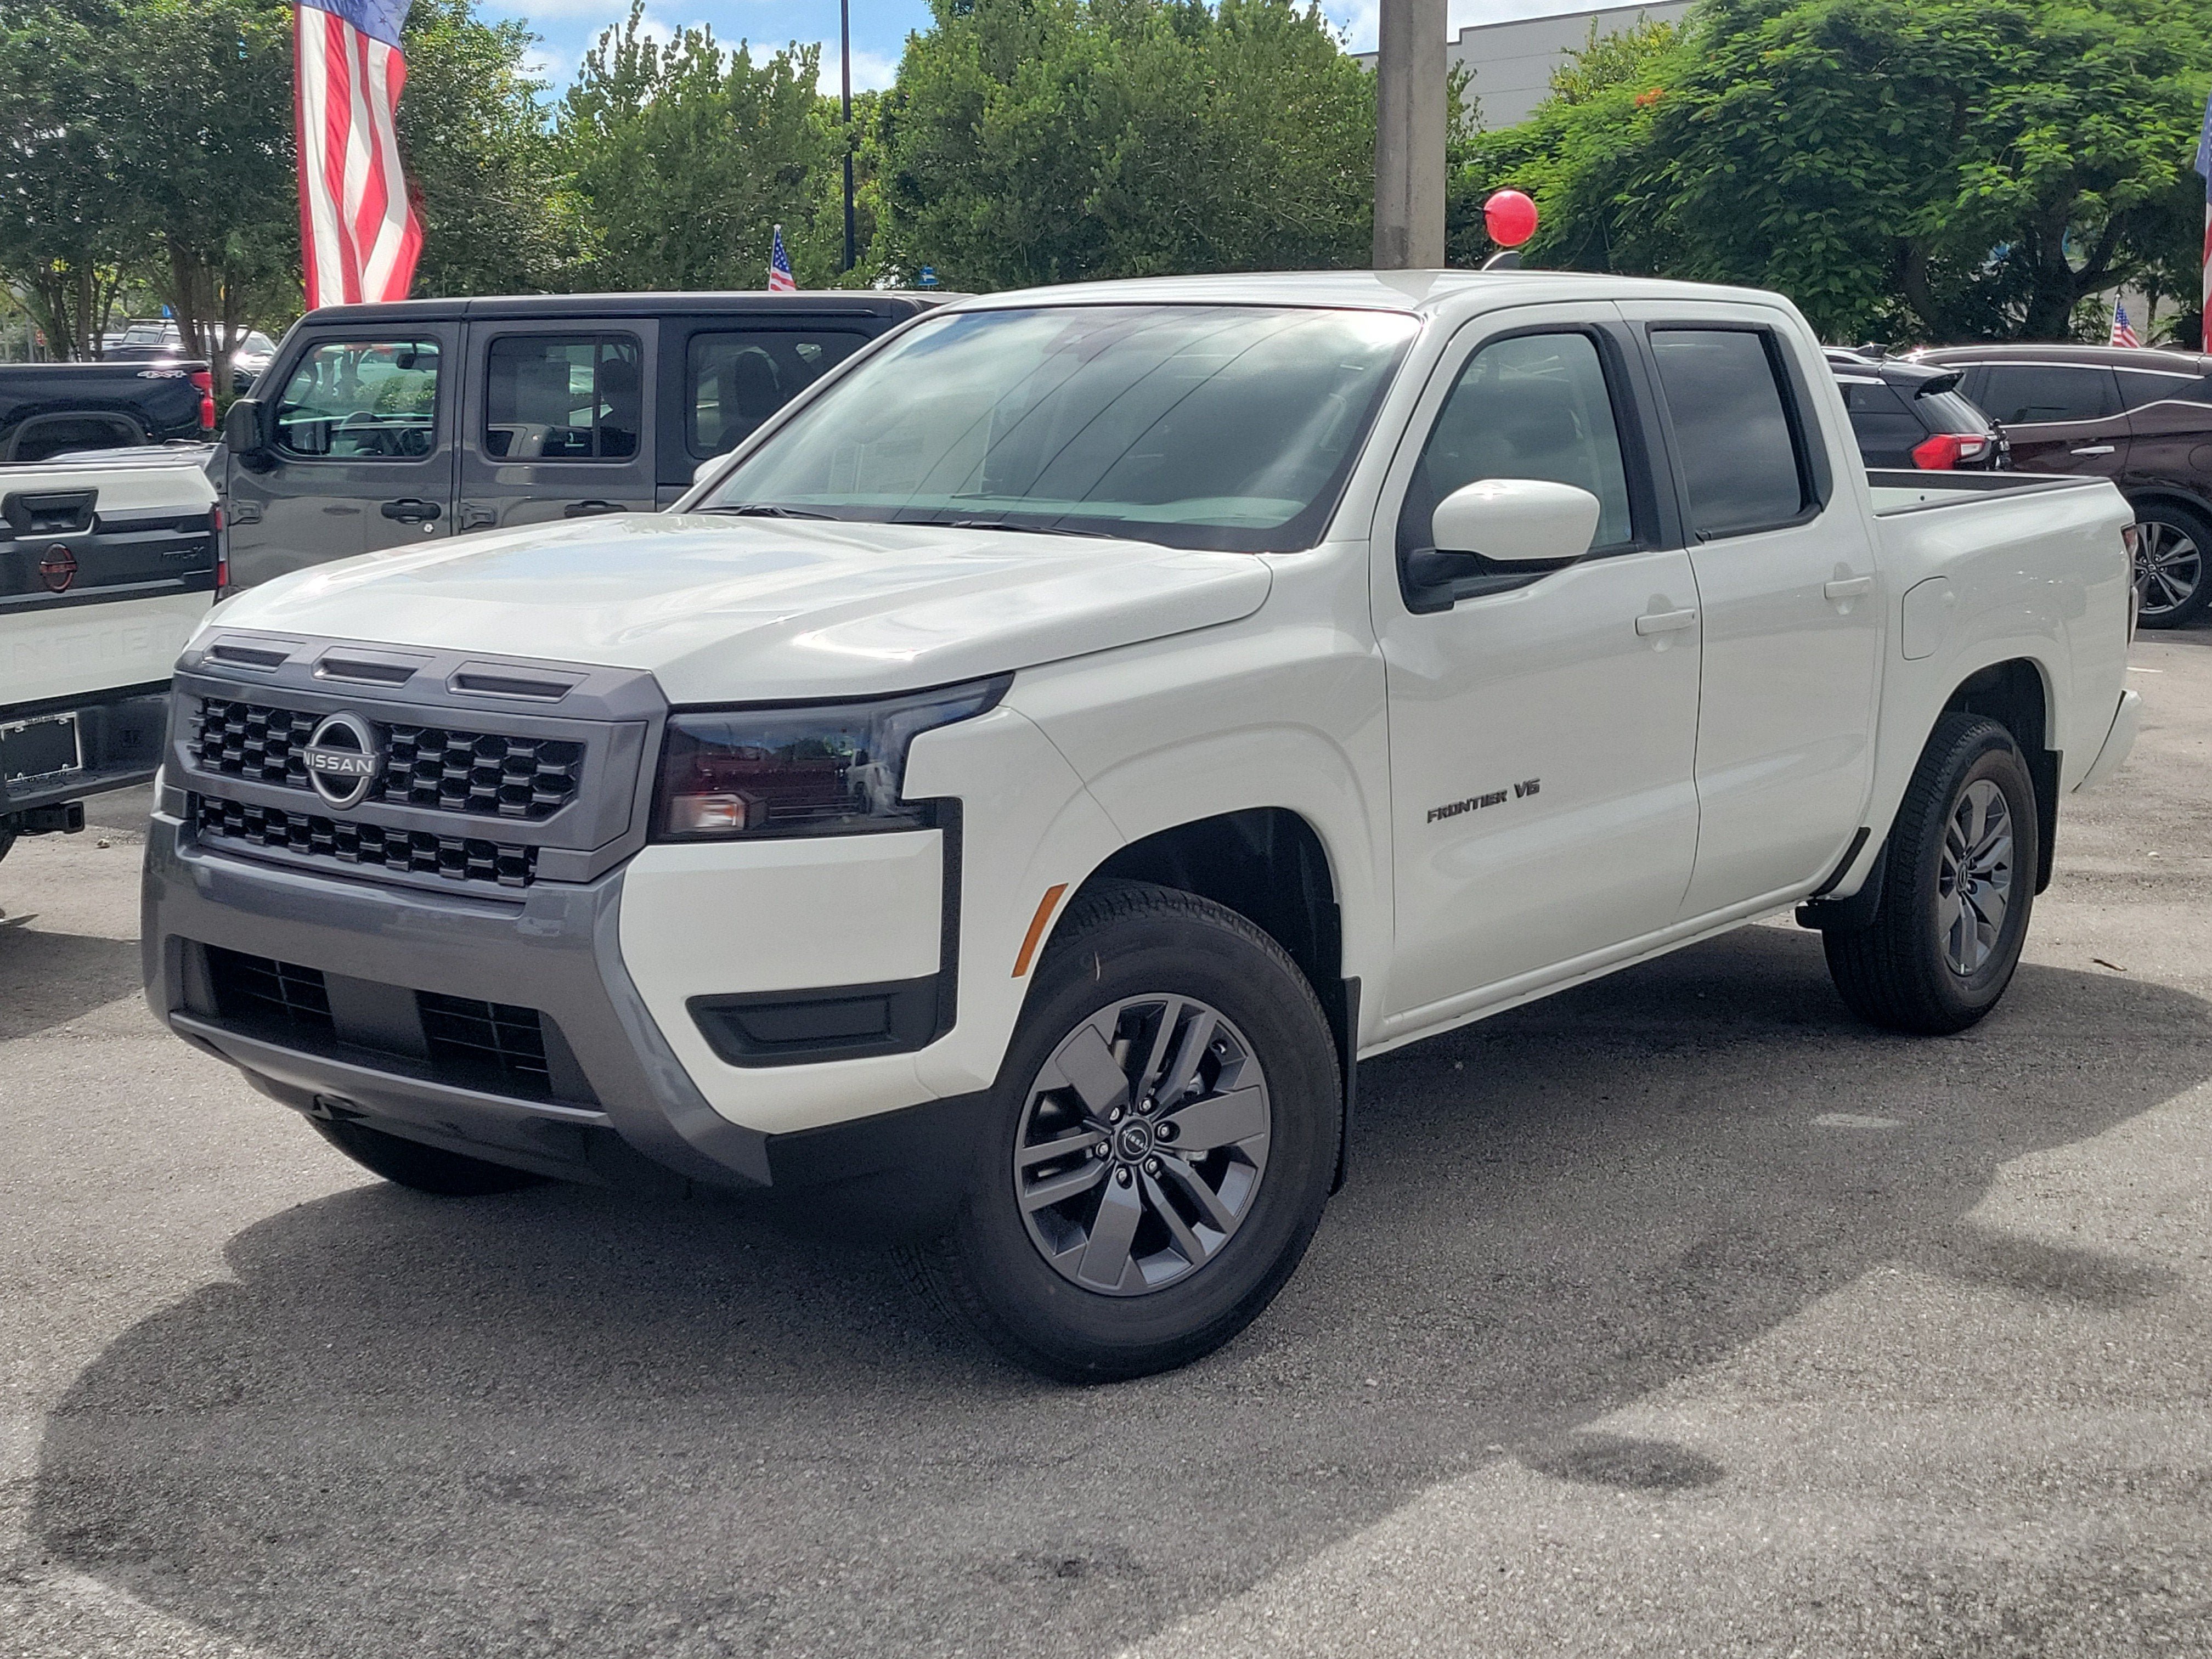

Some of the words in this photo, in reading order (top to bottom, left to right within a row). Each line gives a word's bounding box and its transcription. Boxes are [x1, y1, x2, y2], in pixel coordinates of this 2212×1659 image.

[303, 751, 373, 773] NISSAN
[1427, 789, 1508, 823] FRONTIER
[1514, 777, 1541, 798] V6
[1122, 1130, 1148, 1152] NISSAN
